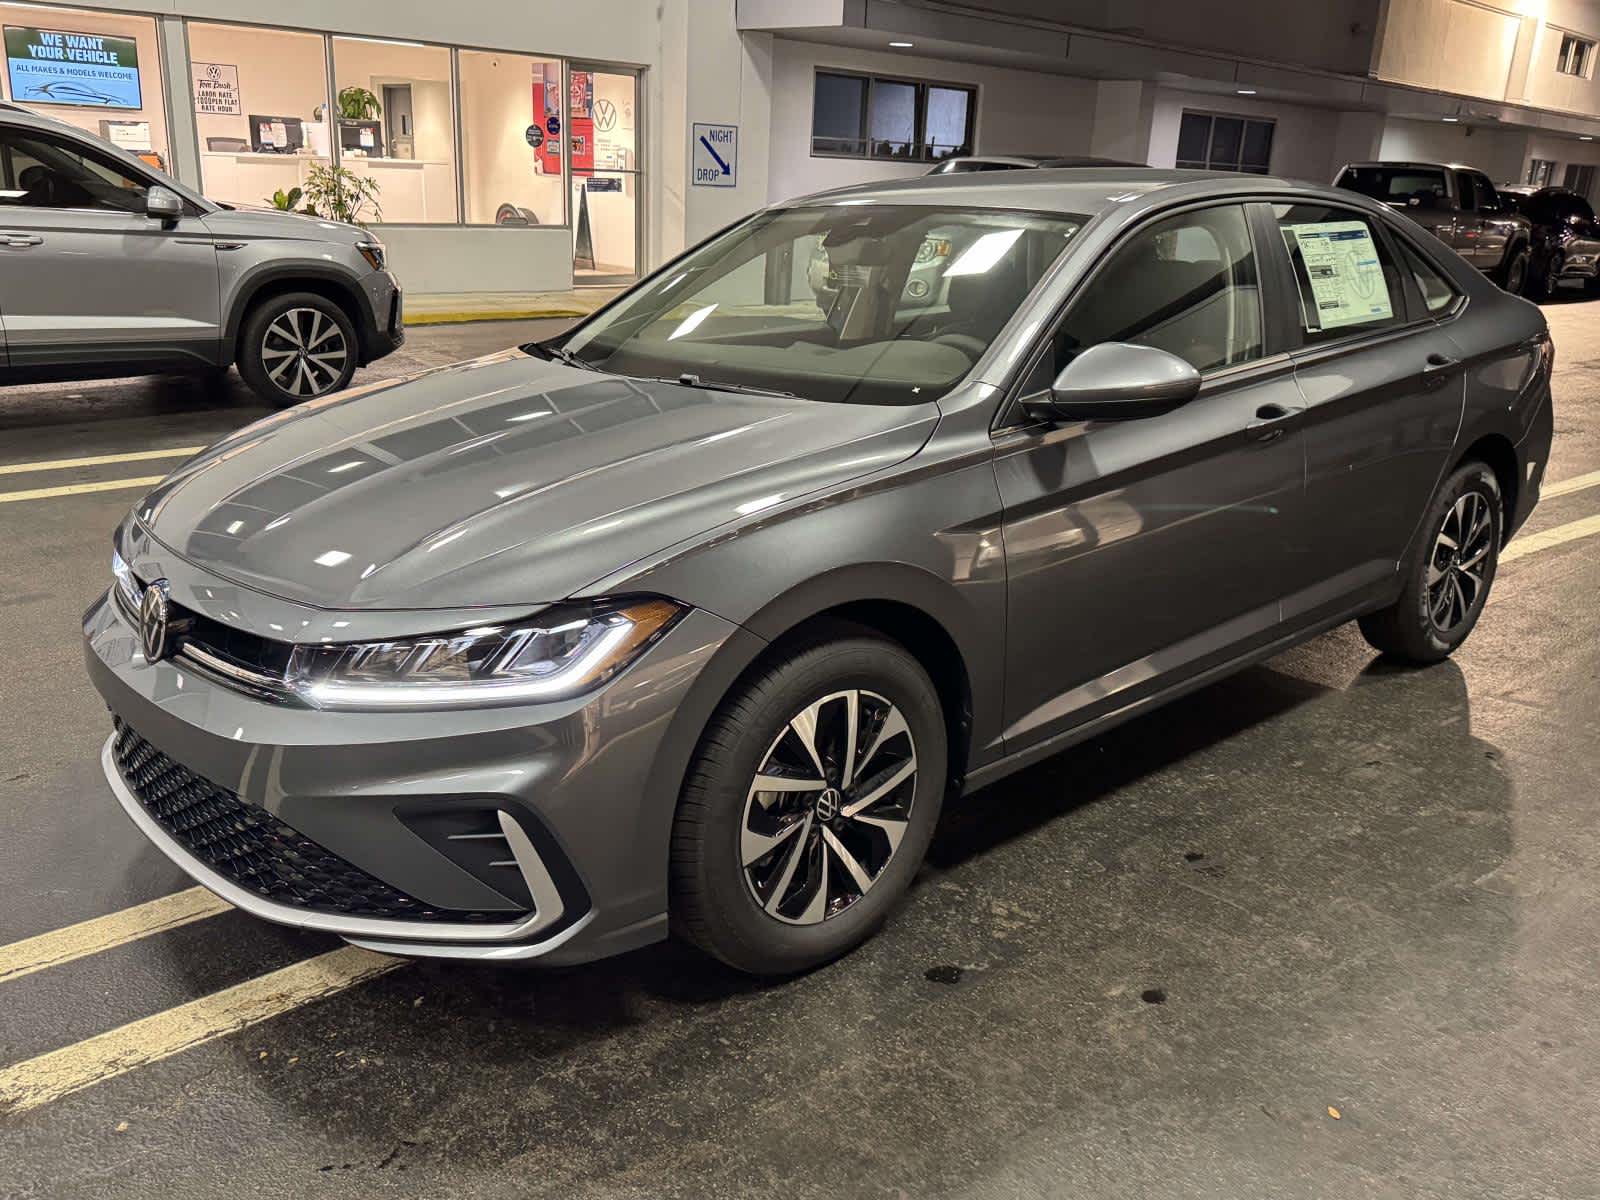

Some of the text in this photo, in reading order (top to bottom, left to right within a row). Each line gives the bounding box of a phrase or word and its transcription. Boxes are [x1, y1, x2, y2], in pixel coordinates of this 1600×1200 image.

[40, 32, 103, 50] WE WANT
[28, 44, 118, 64] YOUR VEHICLE
[16, 64, 133, 80] ALL MAKES & MODELS WELCOME
[201, 104, 216, 112] RATE
[709, 128, 733, 144] NIGHT
[697, 168, 720, 181] DROP
